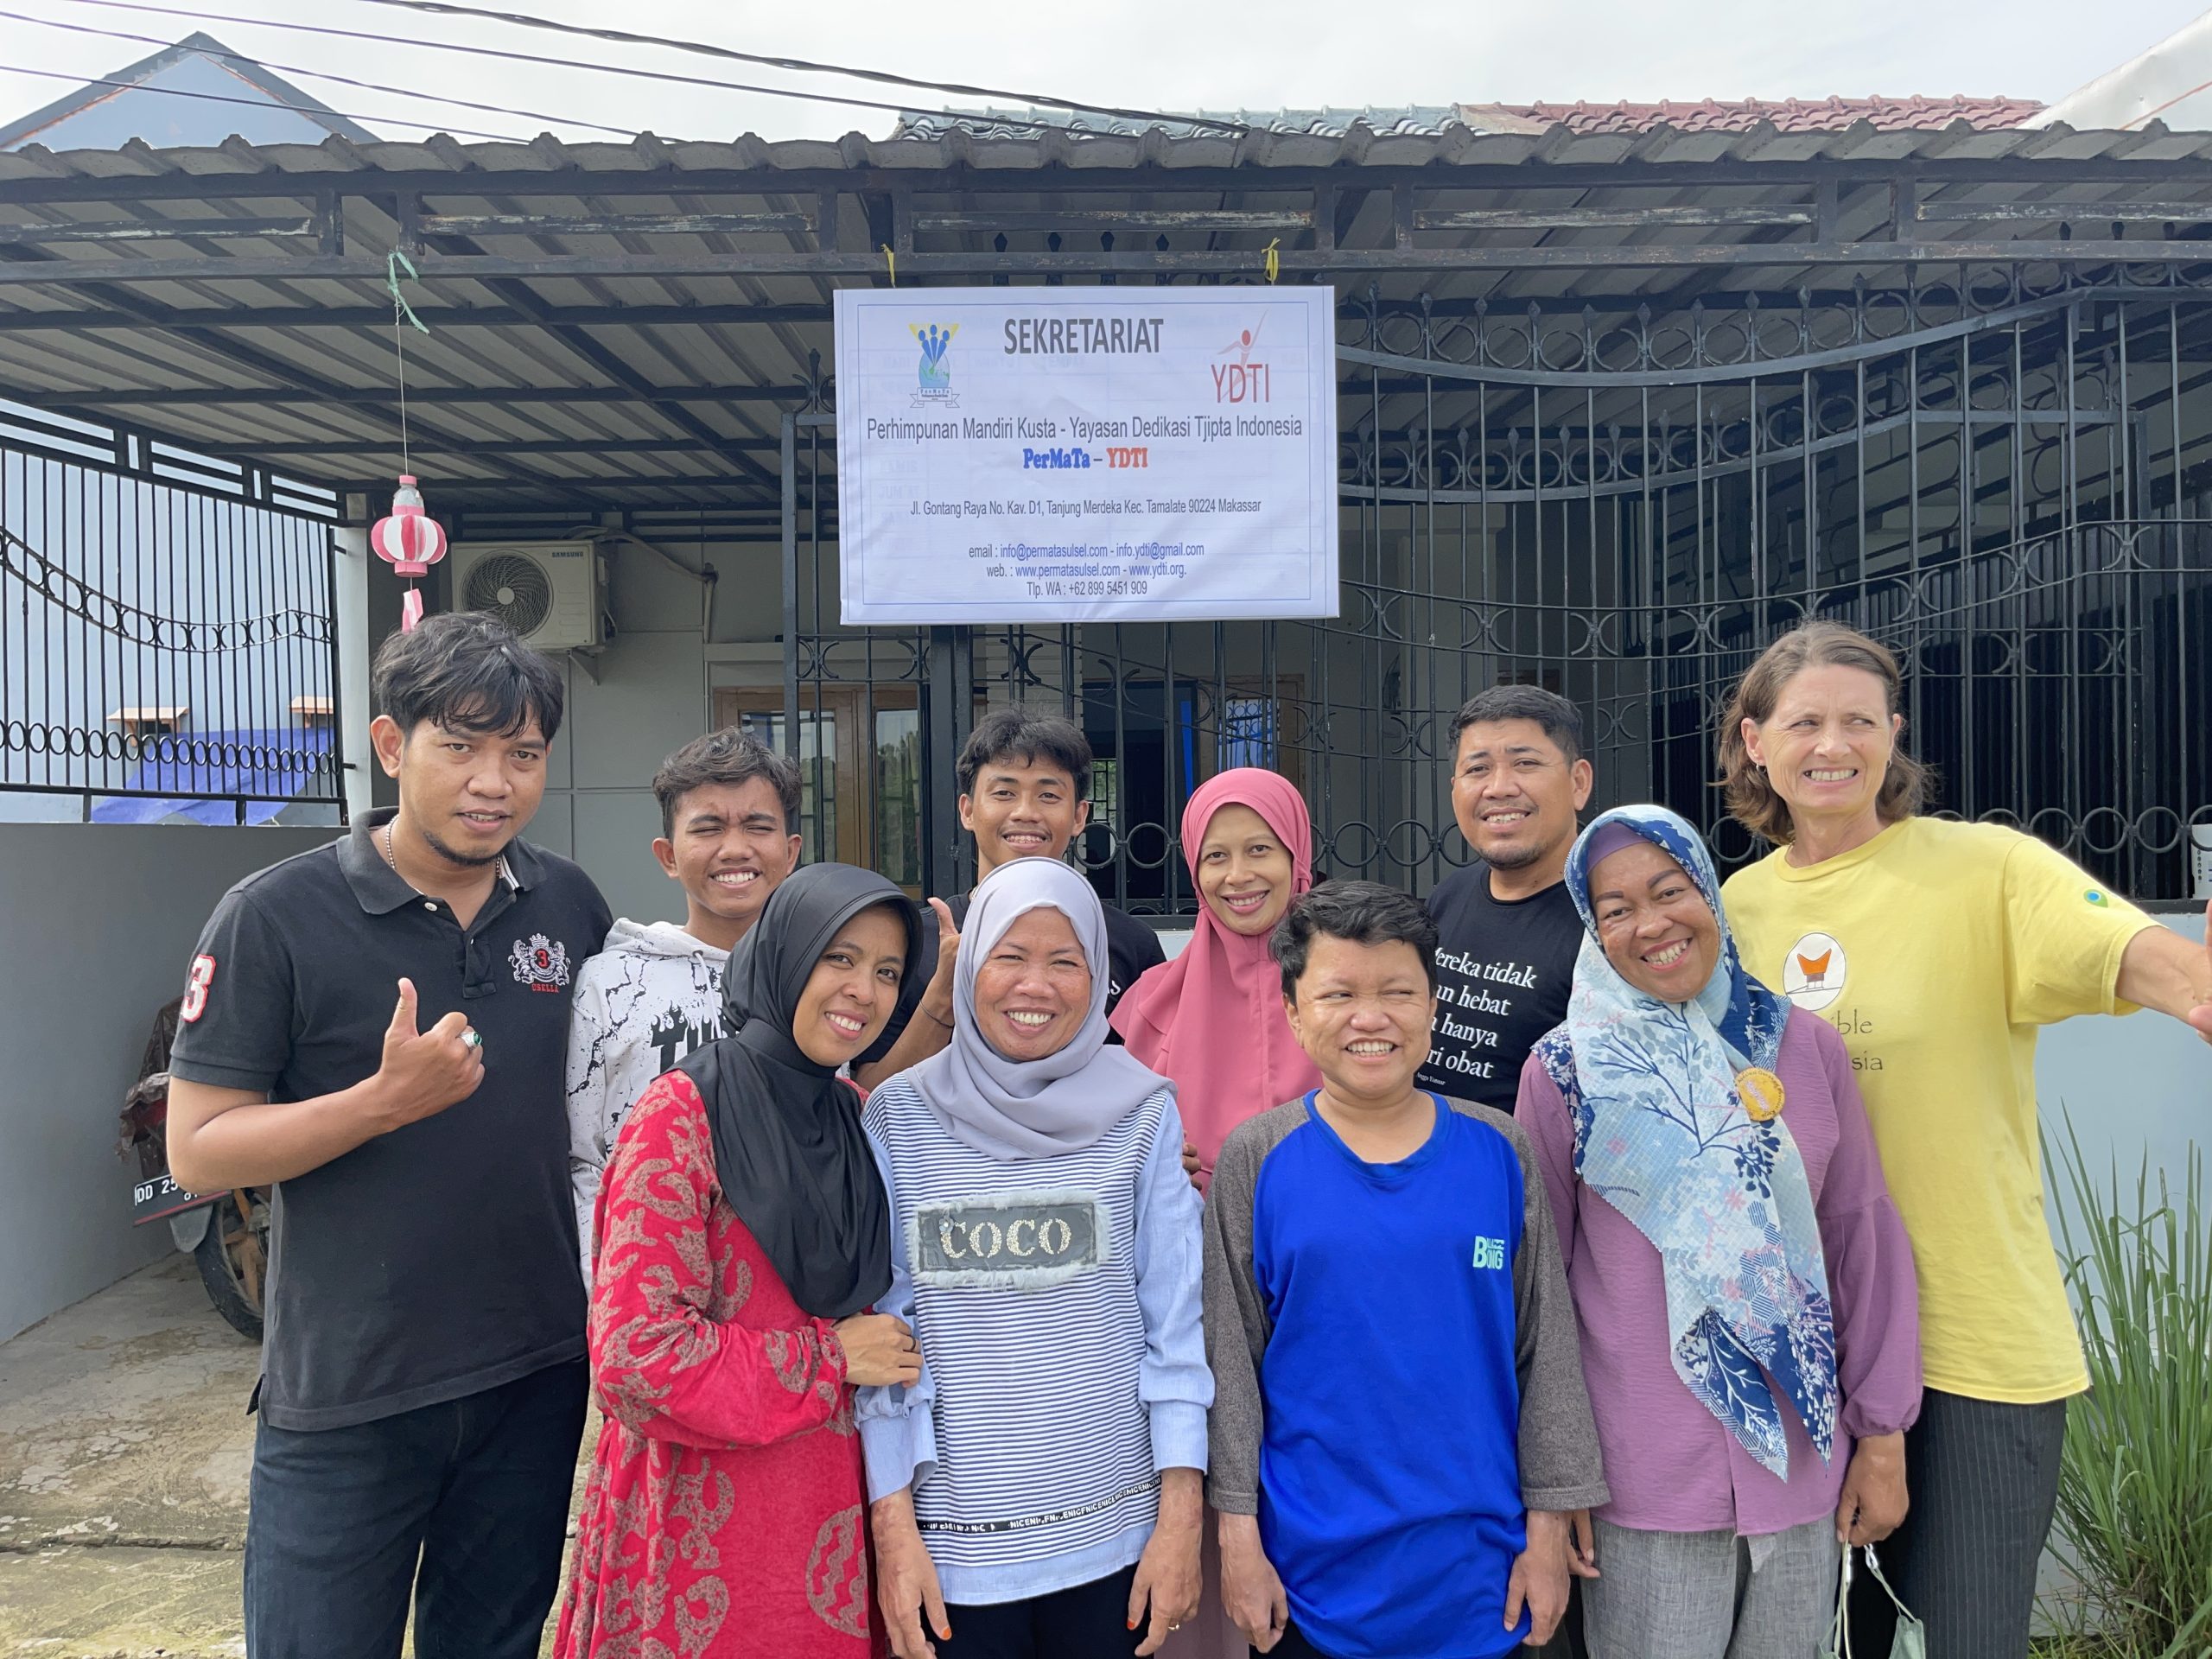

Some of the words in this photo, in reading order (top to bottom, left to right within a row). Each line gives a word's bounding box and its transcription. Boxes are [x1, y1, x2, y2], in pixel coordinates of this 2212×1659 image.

[1004, 319, 1164, 355] SEKRETARIAT
[1211, 364, 1270, 404] YDTI
[868, 418, 958, 444] Perhimpunan
[963, 417, 1014, 440] Mandiri
[1017, 416, 1056, 440] Kusta
[1069, 416, 1128, 444] Yayasan
[1132, 416, 1191, 438] Dedikasi
[1194, 415, 1232, 442] Tjipta
[1236, 414, 1302, 437] Indonesia
[1022, 448, 1090, 469] PerMaTa
[1106, 447, 1148, 469] YDTI
[911, 501, 921, 516] Jl.
[923, 500, 962, 518] Gontang
[963, 501, 988, 519] Raya
[989, 501, 1005, 515] No.
[1007, 500, 1027, 515] Kav.
[1028, 500, 1044, 518] D1,
[1046, 499, 1082, 518] Tanjung
[1084, 499, 1122, 514] Merdeka
[1124, 499, 1144, 514] Kec.
[1146, 499, 1186, 513] Tamalate
[1188, 499, 1216, 513] 90224
[1217, 498, 1261, 513] Makassar
[969, 543, 993, 558] email
[1000, 543, 1108, 562] info@permatasulsel.com
[1116, 543, 1205, 561] info.ydti@gmail.com
[986, 563, 1007, 577] web.
[1014, 563, 1121, 580] www.permatasulsel.com
[1128, 562, 1187, 579] www.ydti.org.
[1026, 582, 1044, 599] Tlp.
[1046, 582, 1062, 596] WA
[1068, 582, 1085, 595] +62
[1087, 582, 1104, 595] 899
[1106, 581, 1128, 595] 5451
[1130, 581, 1147, 594] 909
[537, 950, 549, 967] 3
[182, 954, 216, 1023] 3
[1483, 962, 1537, 989] tidak
[1457, 985, 1511, 1016] hebat
[1440, 1013, 1498, 1049] hanya
[1836, 1008, 1872, 1035] ble
[1426, 1046, 1444, 1066] ri
[1446, 1050, 1494, 1079] obat
[1852, 1050, 1883, 1071] sia
[137, 1185, 153, 1204] DD
[161, 1178, 179, 1194] 25
[938, 1217, 1072, 1260] COCO
